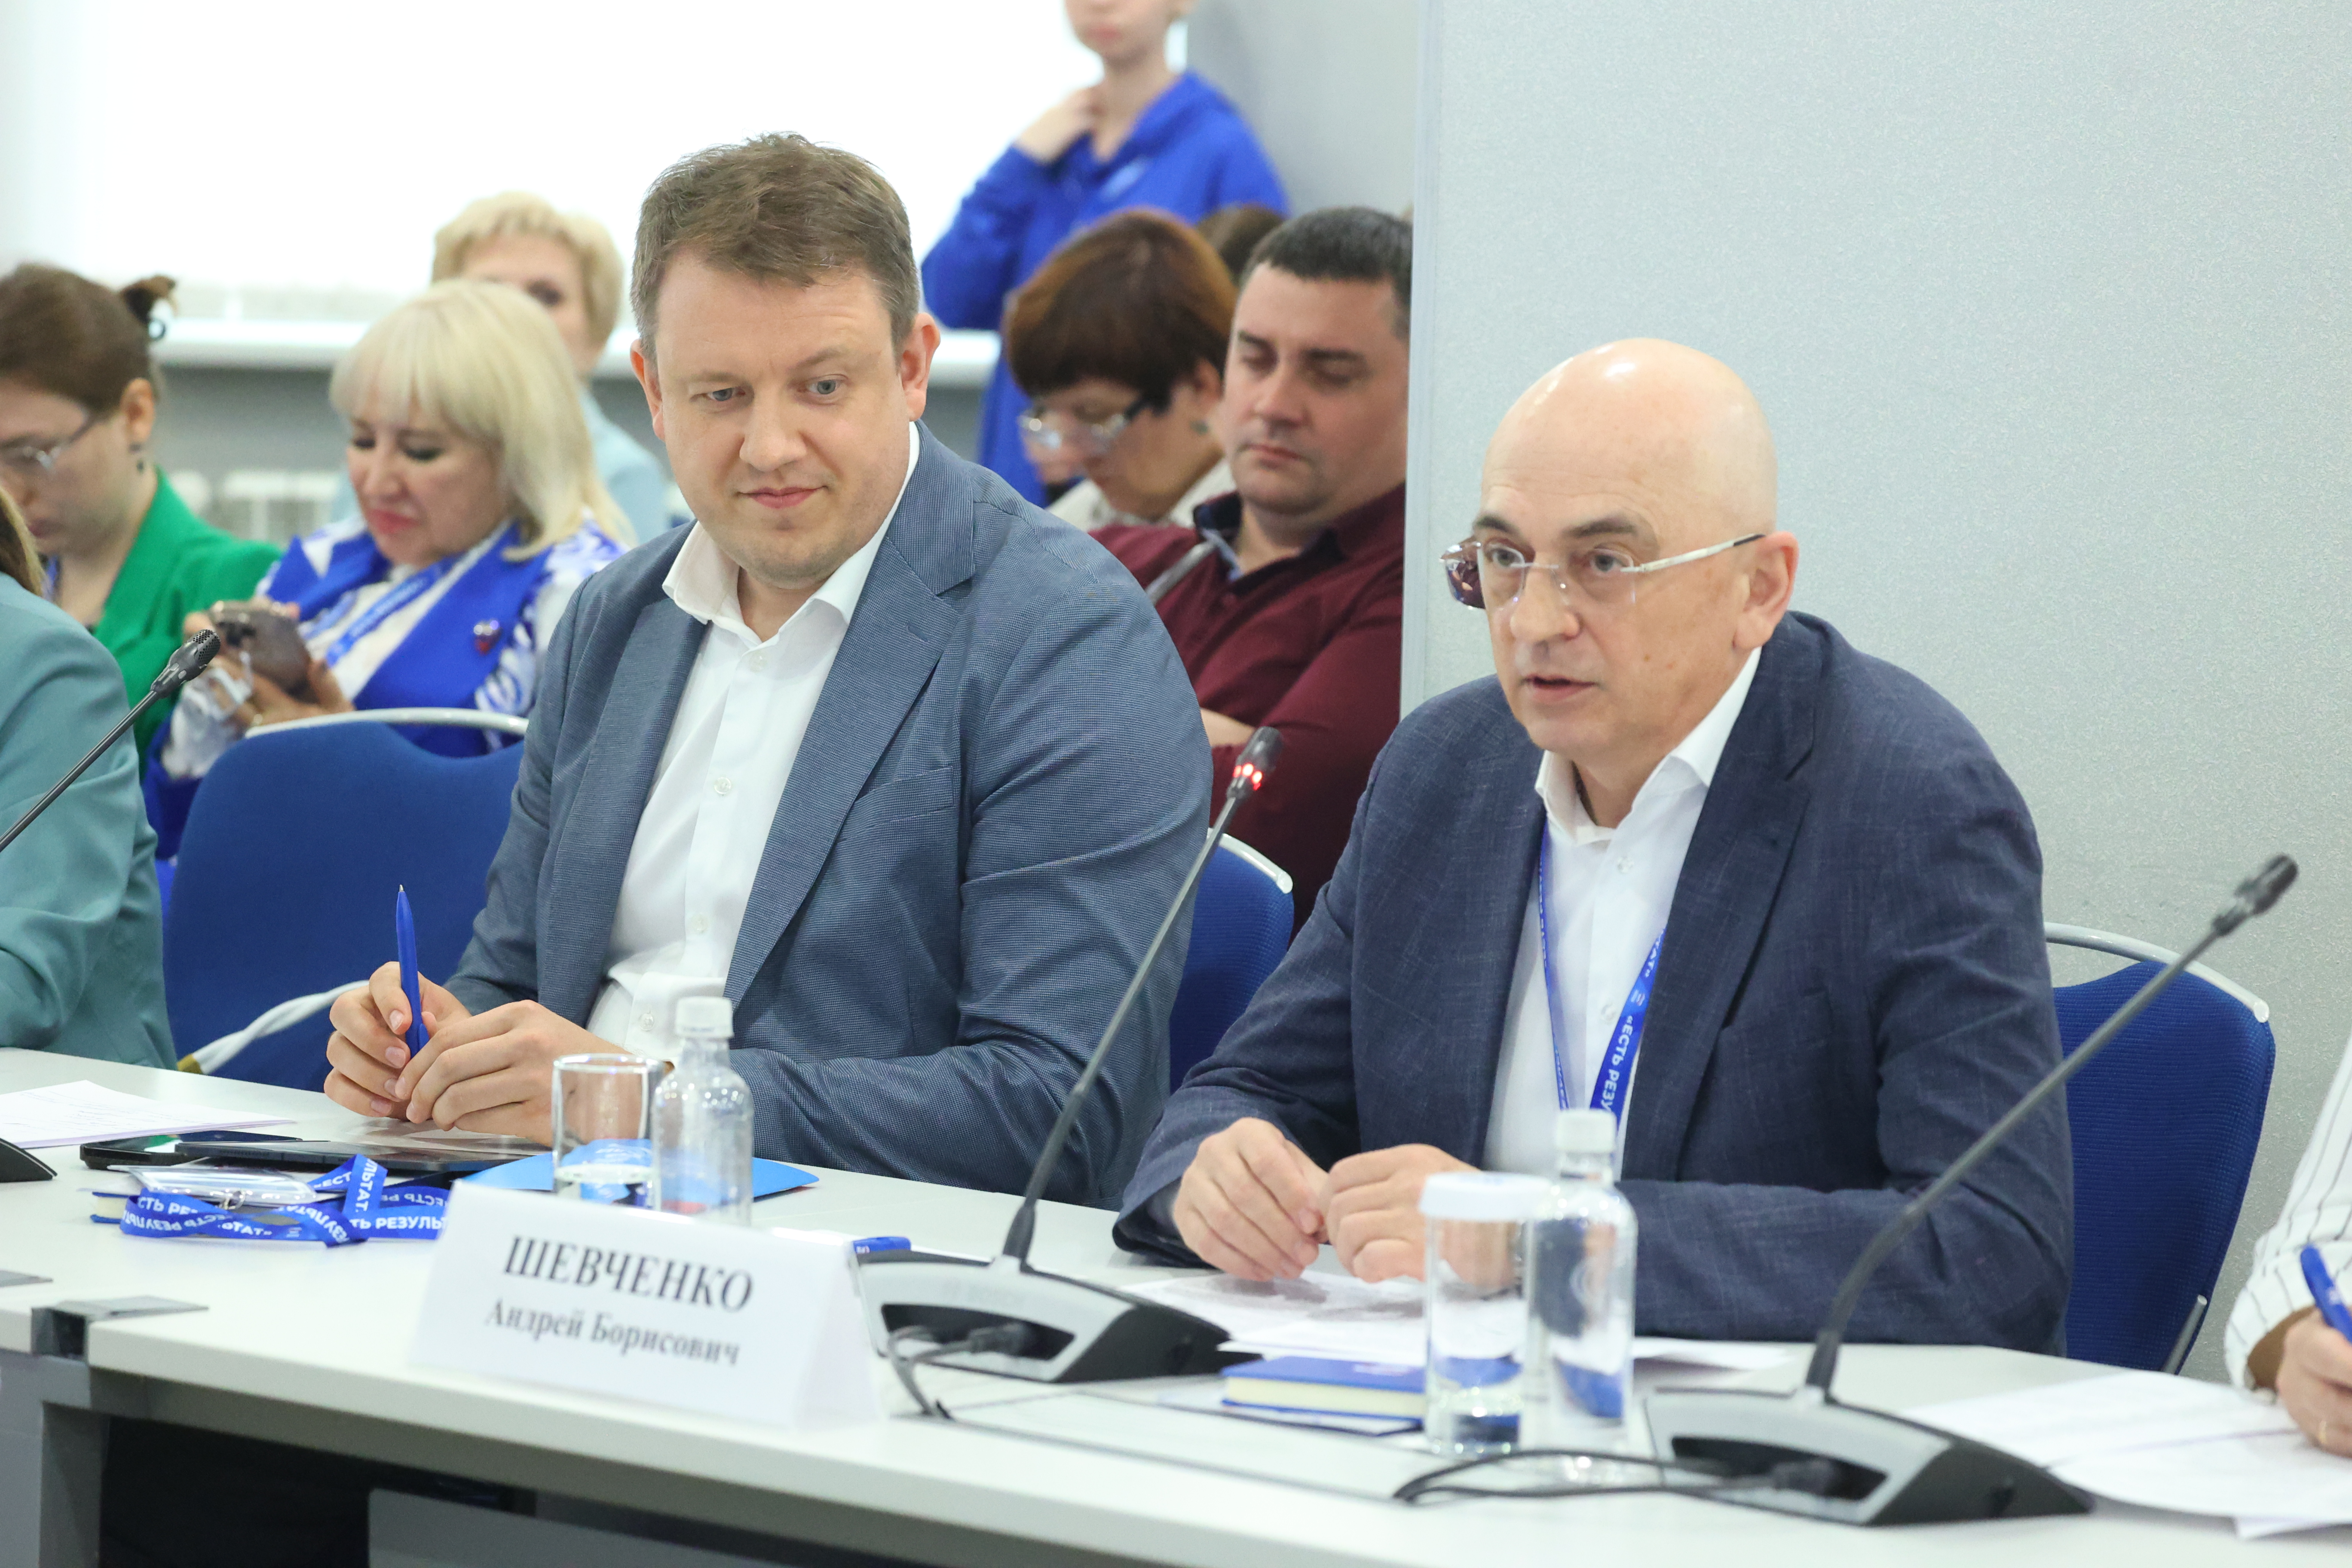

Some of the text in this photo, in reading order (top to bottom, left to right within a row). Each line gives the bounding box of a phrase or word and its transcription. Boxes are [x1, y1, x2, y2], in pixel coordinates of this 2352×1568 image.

[1612, 1015, 1633, 1066] «ЕСТЬ
[404, 1193, 445, 1207] ЕСТЬ
[504, 1236, 754, 1313] ШЕВЧЕНКО
[485, 1297, 740, 1365] Андрей Борисович
